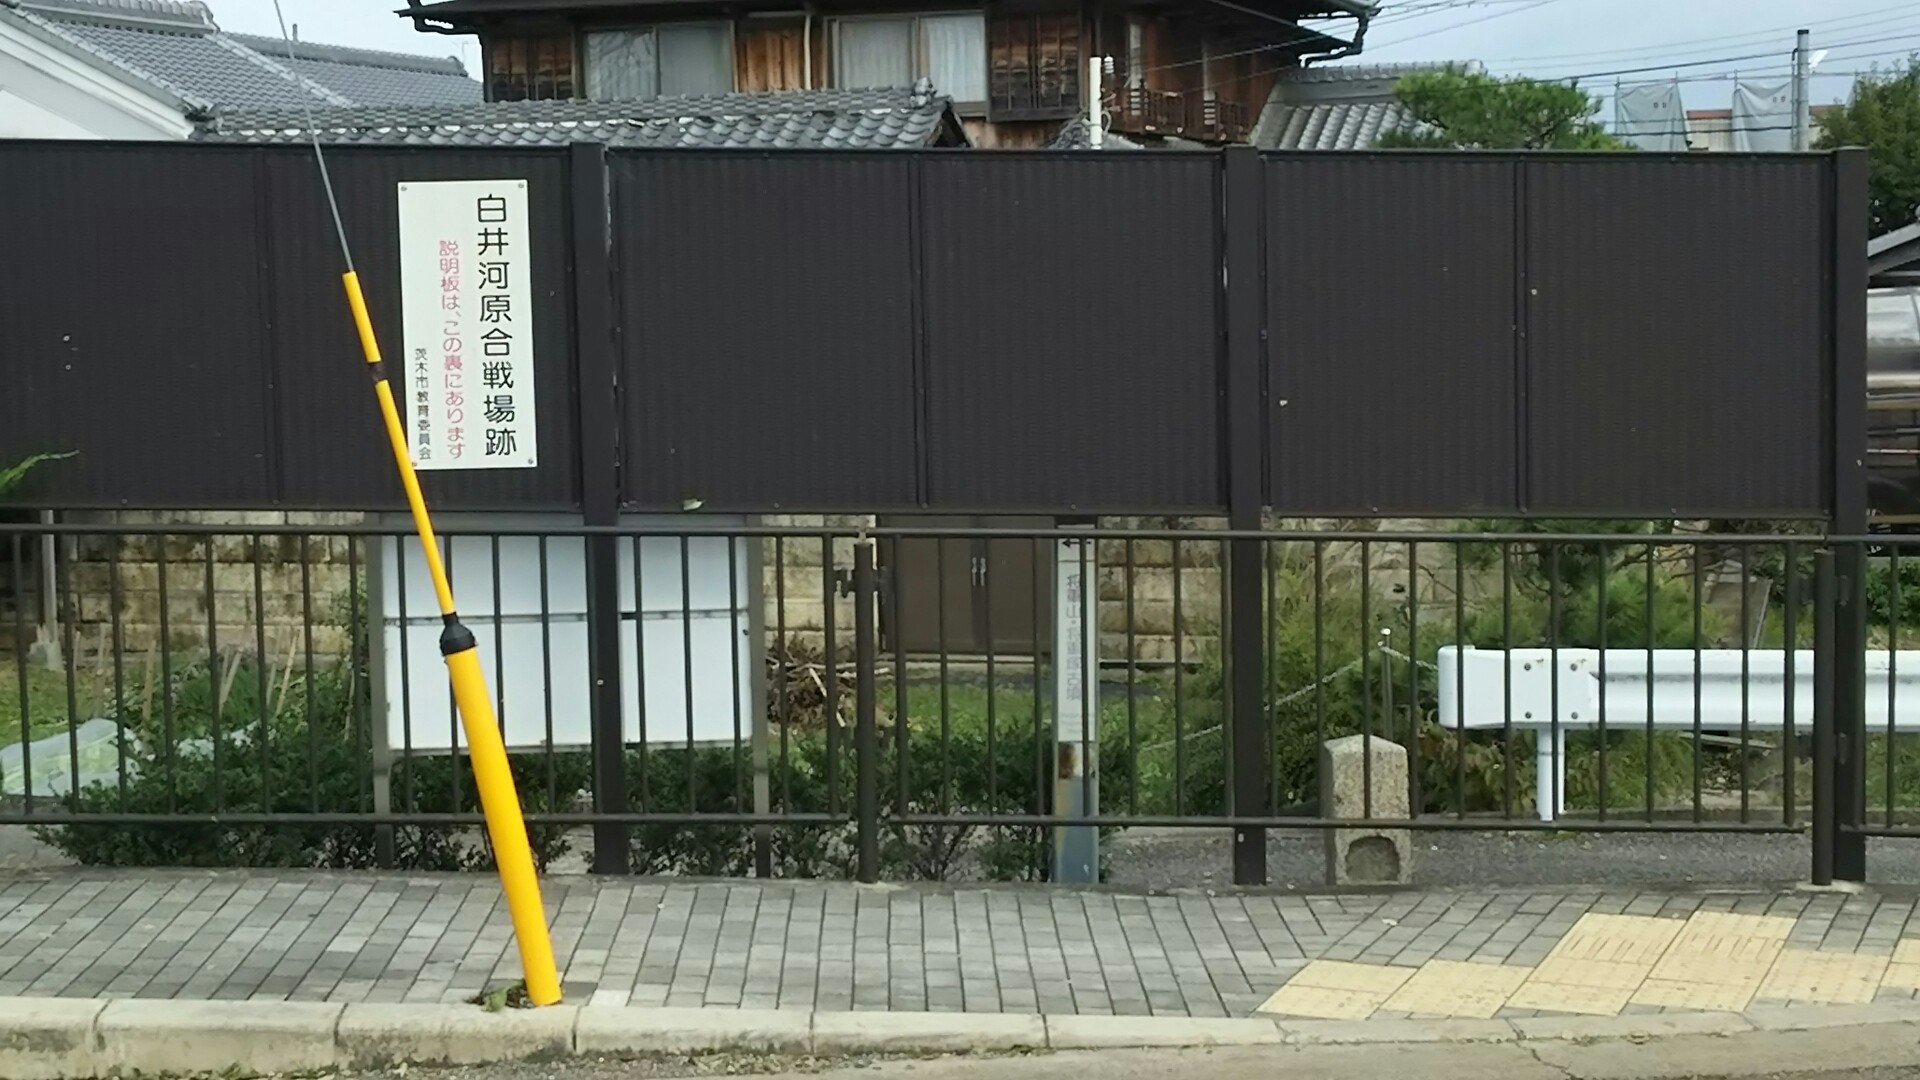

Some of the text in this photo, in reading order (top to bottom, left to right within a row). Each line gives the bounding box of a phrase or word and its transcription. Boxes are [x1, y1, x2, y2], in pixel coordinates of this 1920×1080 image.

[414, 348, 432, 461] 茨木市教育委員会
[438, 240, 466, 460] 説明板は、この裏にあります
[477, 193, 518, 457] 白井河原合戦場跡
